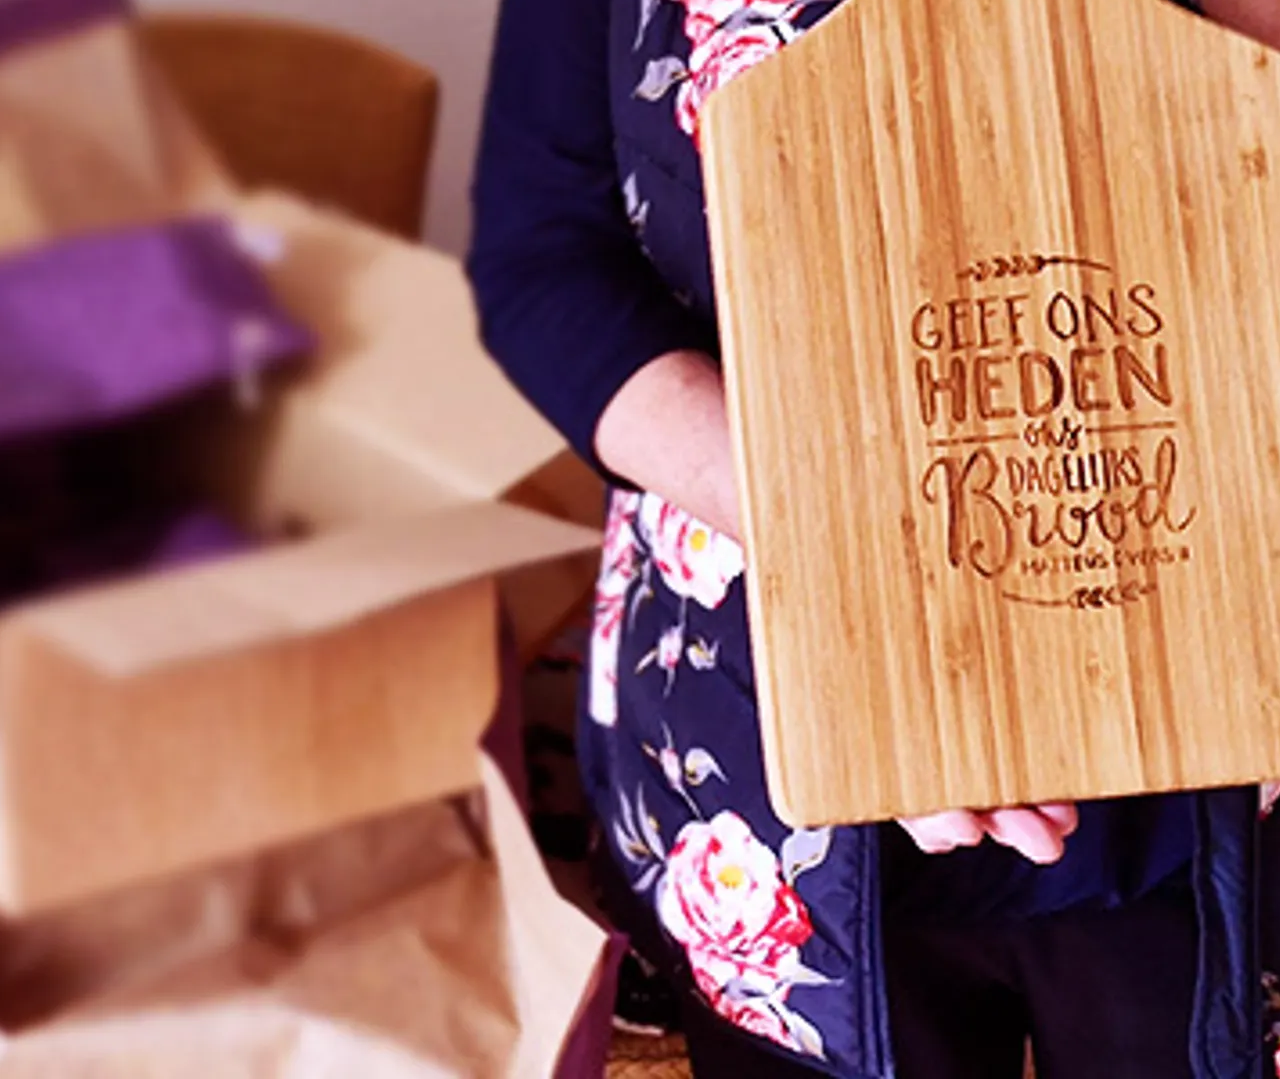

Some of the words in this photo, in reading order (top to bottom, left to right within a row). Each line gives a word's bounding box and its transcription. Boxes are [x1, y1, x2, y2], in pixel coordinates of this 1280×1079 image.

[911, 295, 1029, 351] GEEF
[1046, 282, 1164, 343] ONS
[916, 343, 1173, 427] HEDEN
[921, 436, 1197, 579] Brood
[1005, 445, 1144, 497] DAGELIJKS
